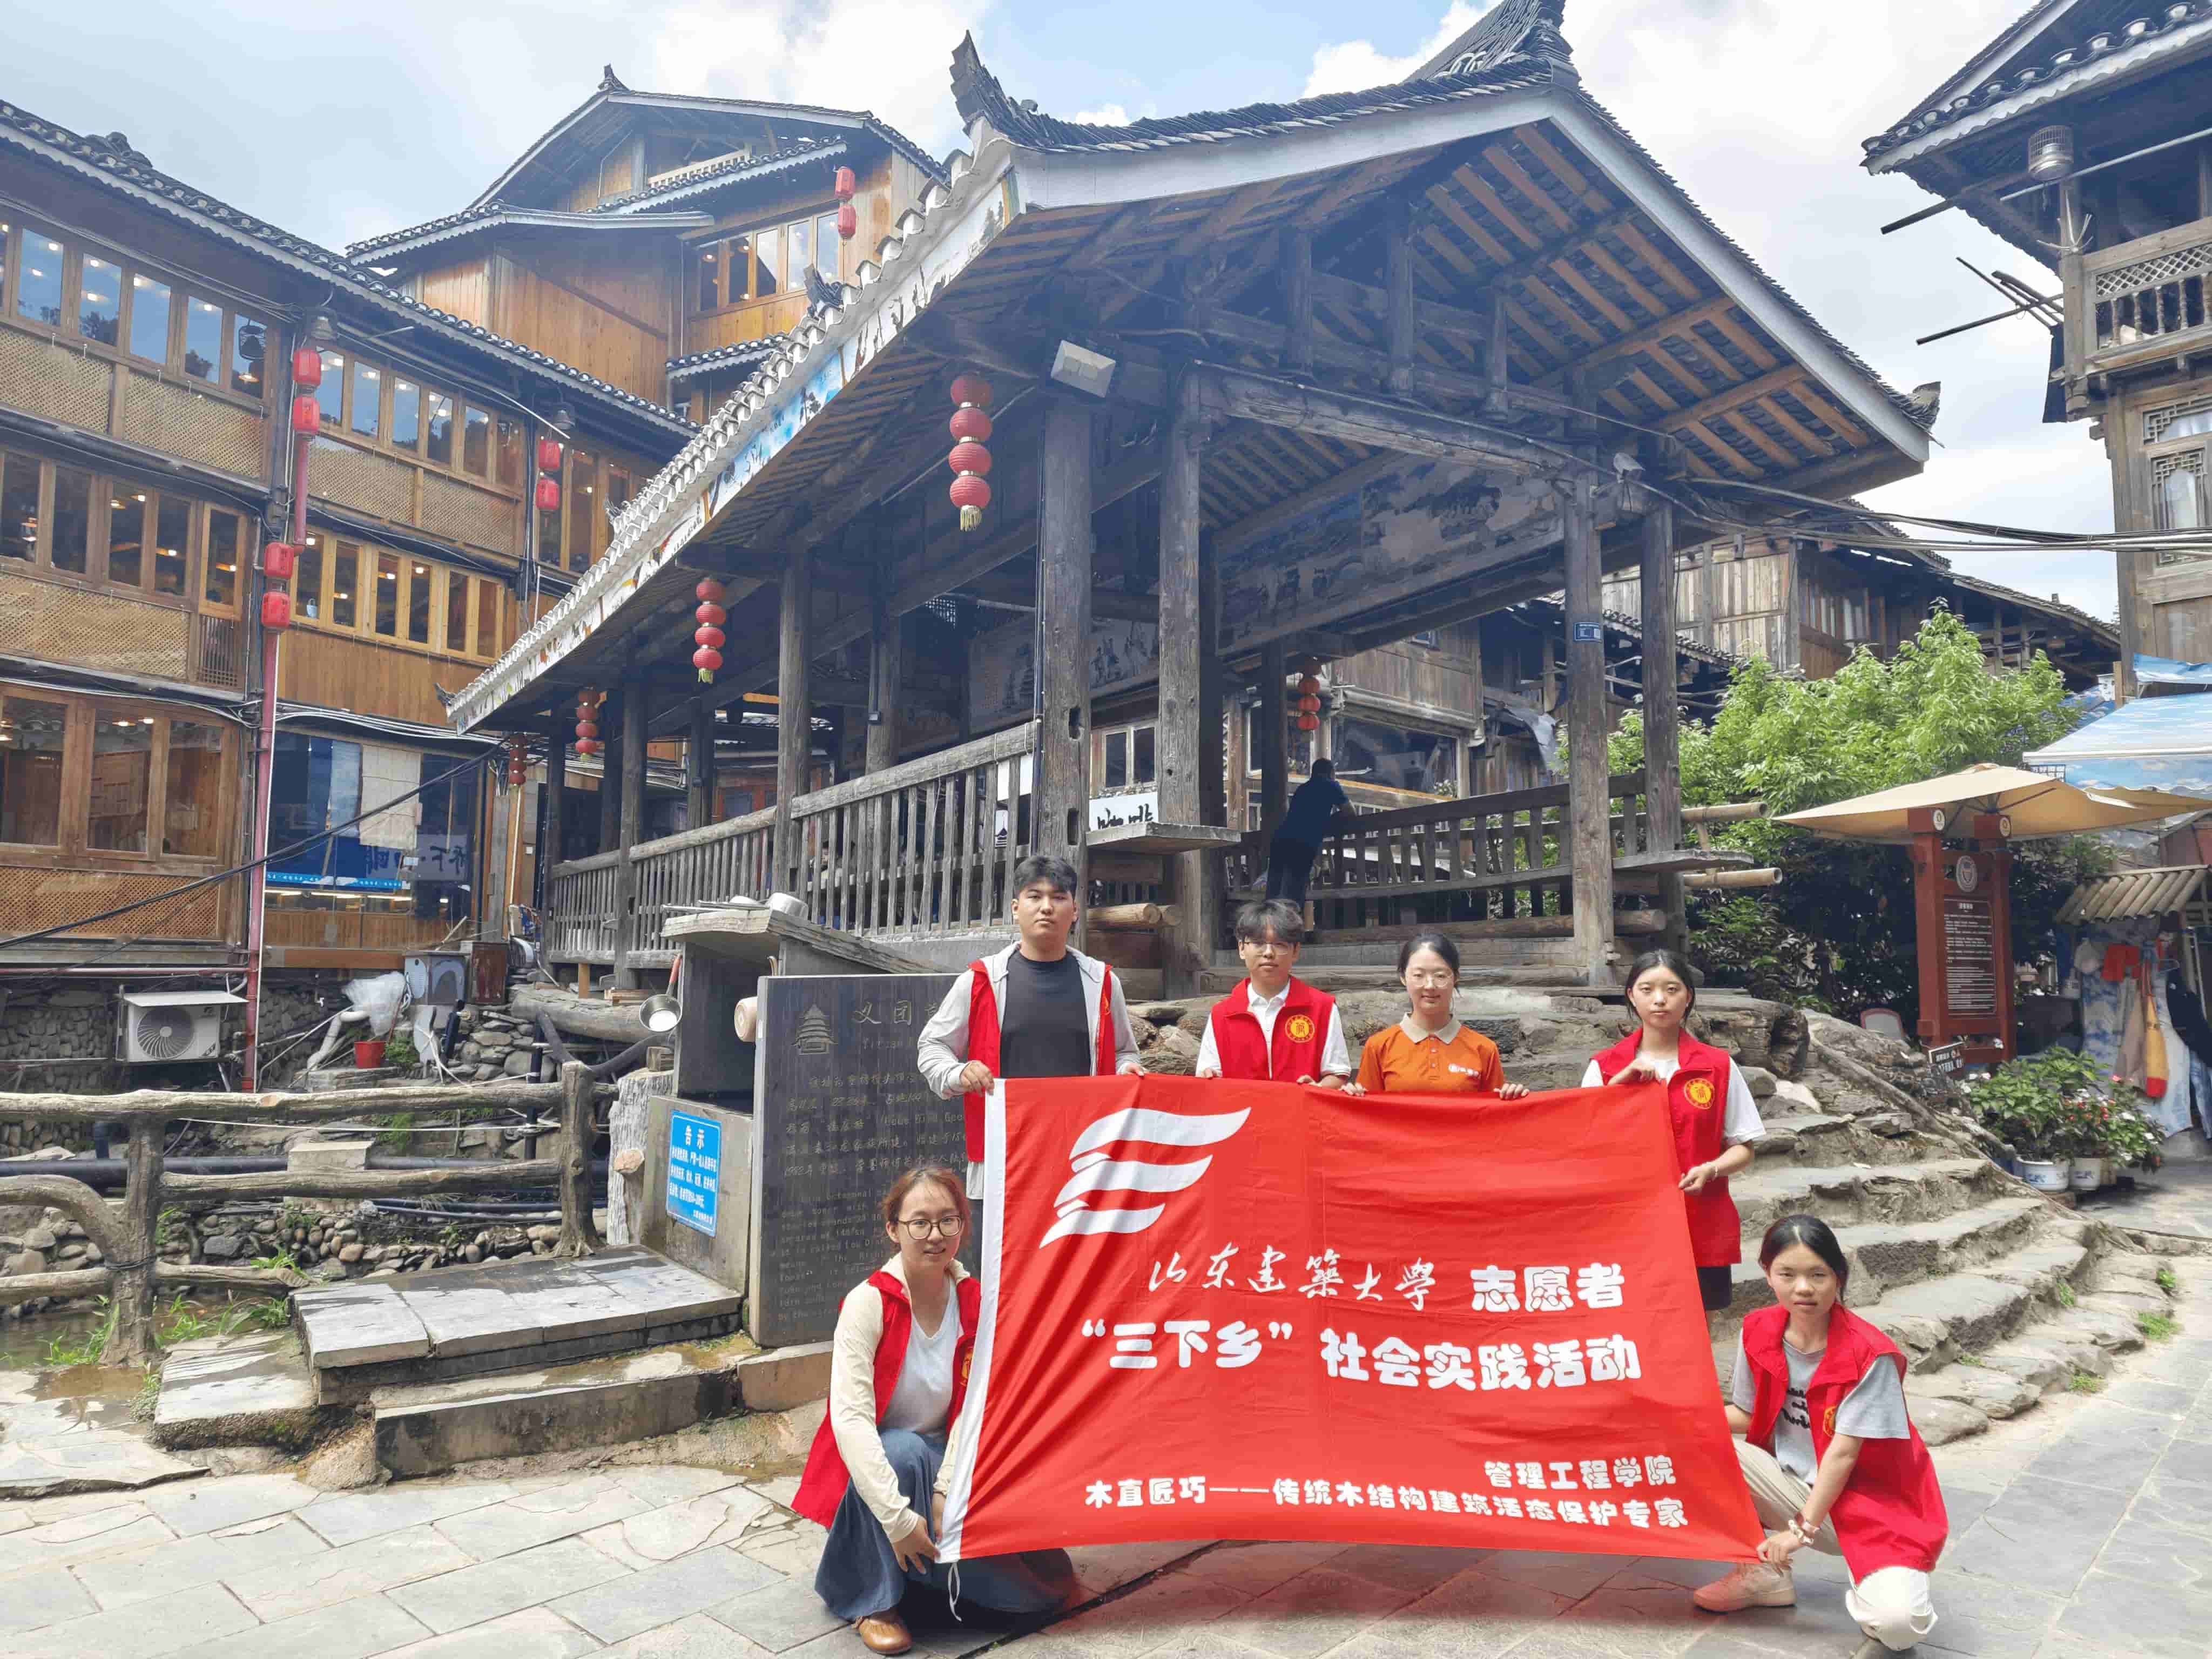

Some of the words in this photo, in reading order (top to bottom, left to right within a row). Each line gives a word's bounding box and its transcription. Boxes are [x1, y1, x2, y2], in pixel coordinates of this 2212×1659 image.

[1469, 1262, 1625, 1312] 志愿者
[1320, 1327, 1642, 1391] 社会实践活动
[1484, 1454, 1676, 1490] 管理工程学院
